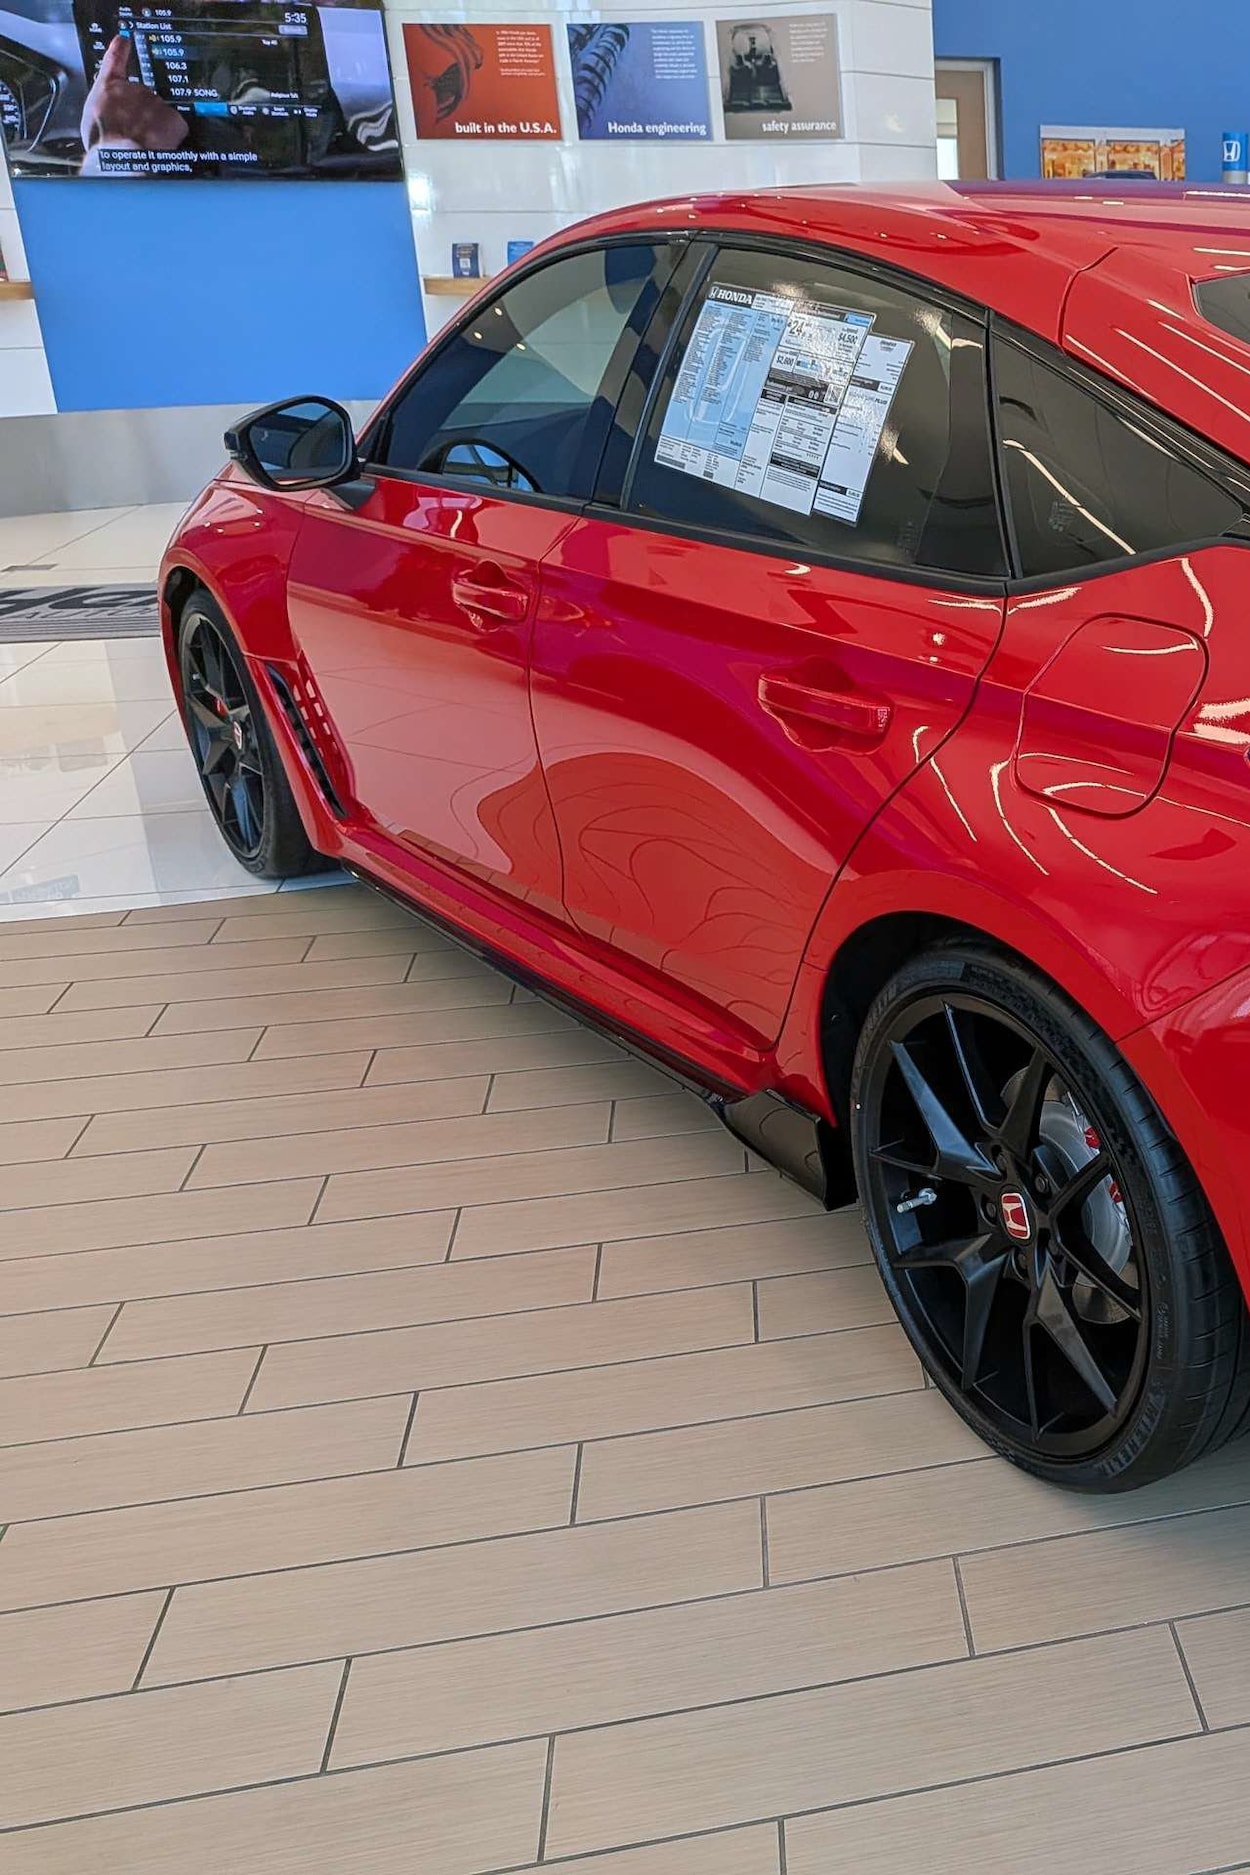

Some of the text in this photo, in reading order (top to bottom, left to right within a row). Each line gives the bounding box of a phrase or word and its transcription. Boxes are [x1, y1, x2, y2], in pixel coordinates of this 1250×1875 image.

[284, 12, 307, 23] 5:35
[136, 22, 159, 30] Station
[160, 34, 182, 43] 105.9
[162, 48, 185, 57] 105.9
[165, 61, 187, 70] 106.3
[168, 75, 189, 83] 107.1
[170, 87, 218, 97] 107.9 SONG
[455, 121, 557, 134] built in the U.S.A.
[607, 121, 707, 136] Honda engineering
[762, 120, 837, 134] safety assurance
[100, 150, 110, 159] to
[111, 152, 147, 163] operate
[148, 150, 155, 160] it
[156, 151, 198, 163] smoothly
[199, 152, 219, 161] with
[228, 152, 258, 163] simple
[102, 162, 193, 173] layout and graphics,
[717, 289, 753, 304] HONDA
